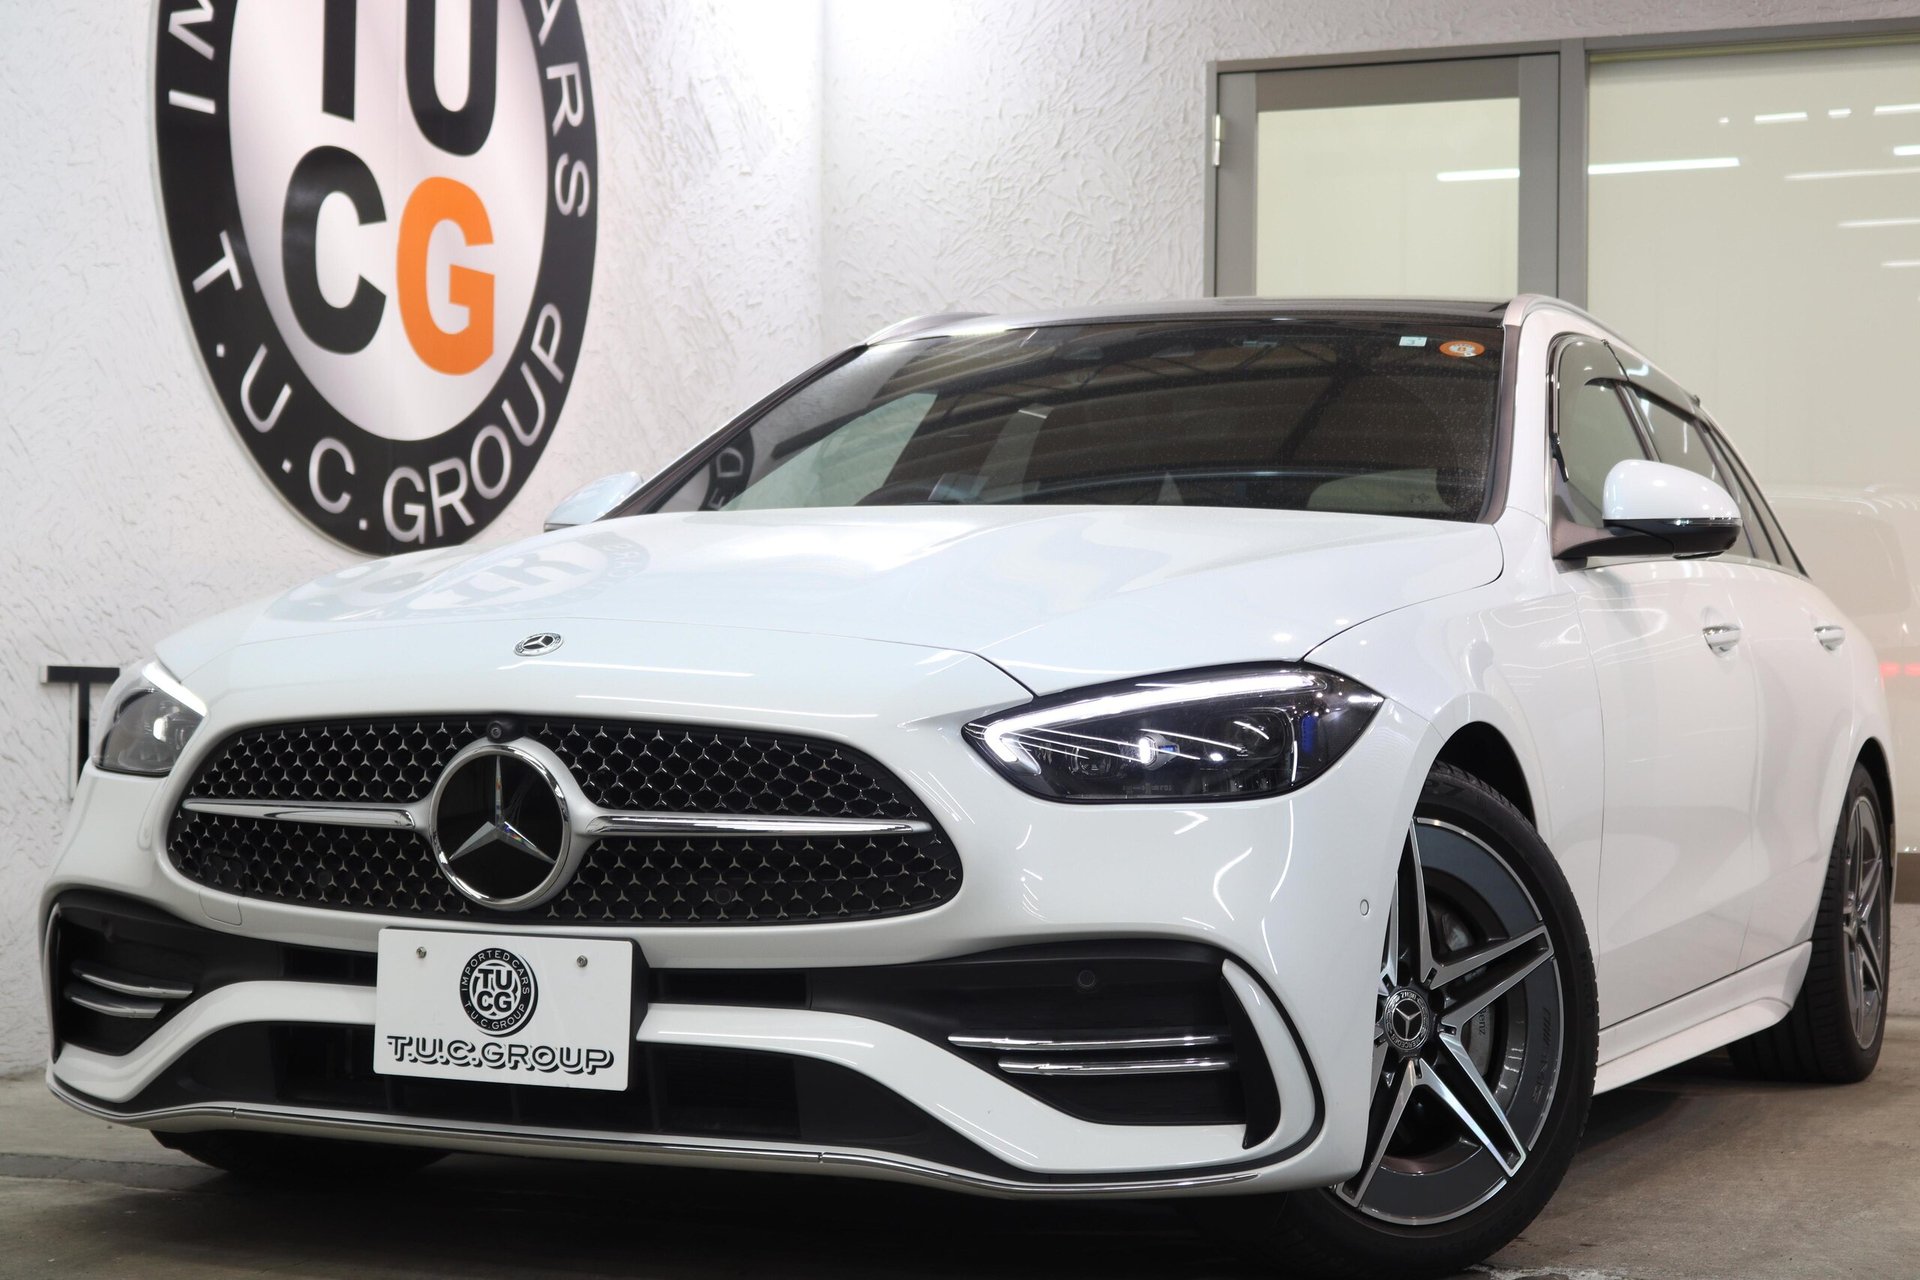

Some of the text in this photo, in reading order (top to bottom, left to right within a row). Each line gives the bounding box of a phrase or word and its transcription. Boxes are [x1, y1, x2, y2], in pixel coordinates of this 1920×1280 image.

[282, 145, 495, 376] CG
[461, 950, 530, 995] IMPORTED CARS
[478, 968, 512, 990] TU
[477, 990, 512, 1012] CG
[387, 1035, 615, 1076] T.U.C.GROUP
